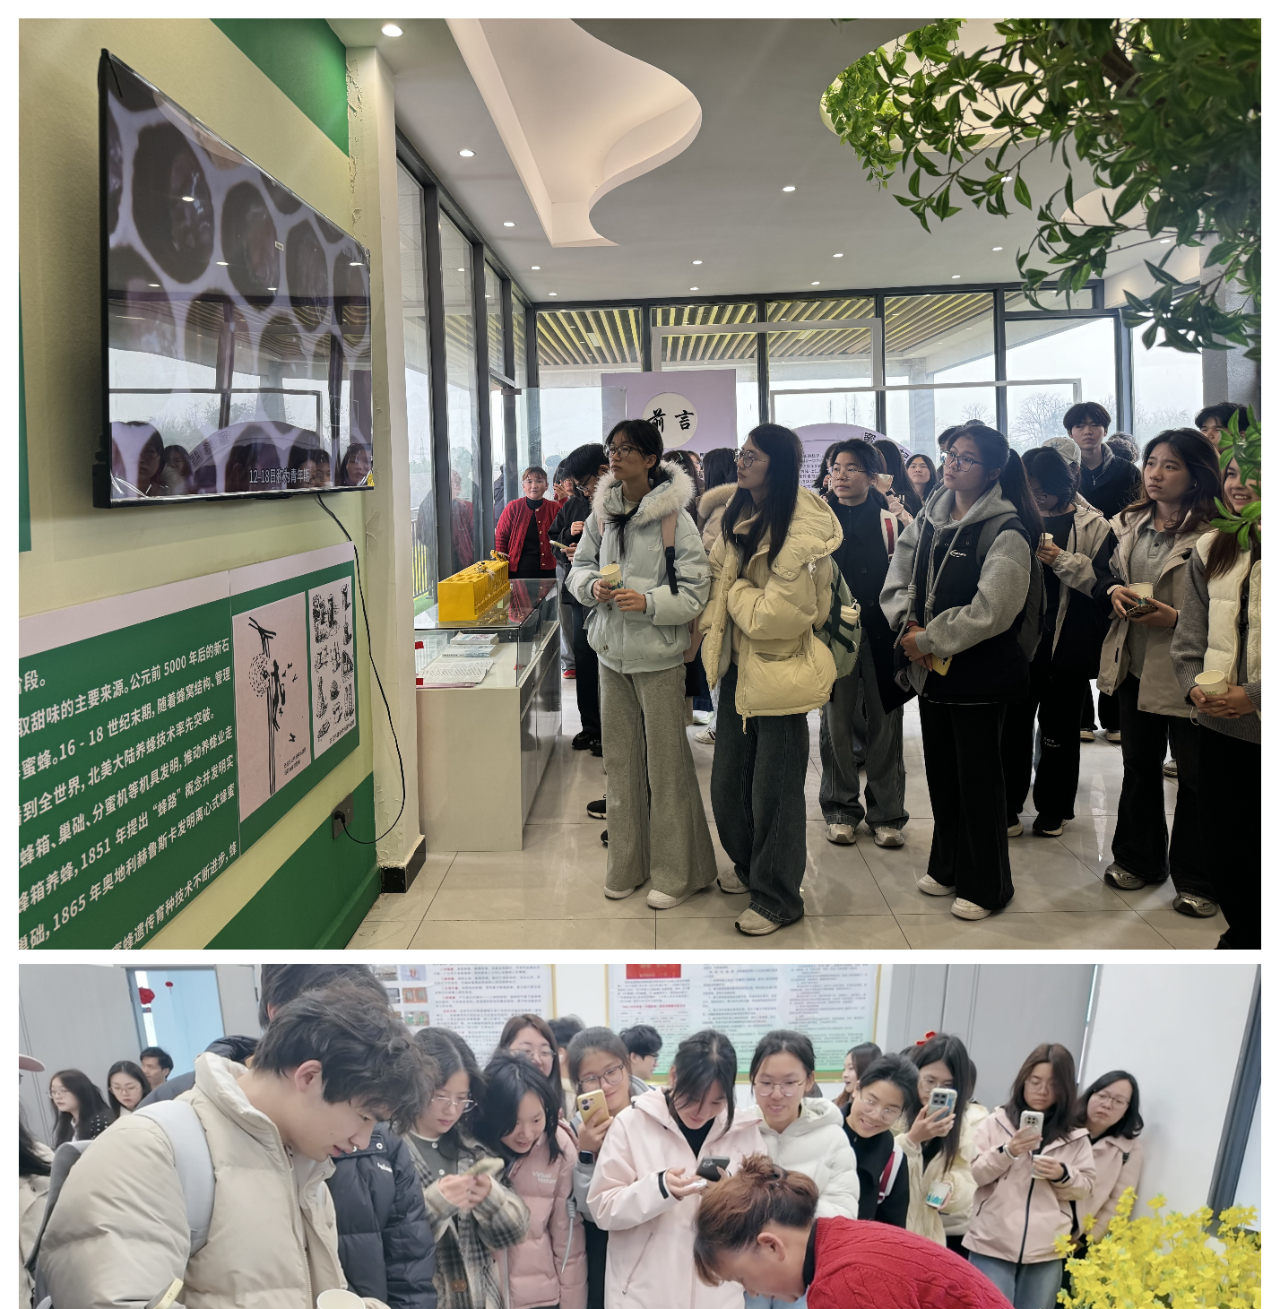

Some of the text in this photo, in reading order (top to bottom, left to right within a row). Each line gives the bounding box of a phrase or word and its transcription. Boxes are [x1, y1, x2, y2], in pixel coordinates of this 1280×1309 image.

[647, 407, 695, 433] 前言
[164, 655, 187, 676] 5000
[189, 637, 230, 666] 年后的新石
[19, 739, 76, 780] 蜜蜂。16
[89, 726, 104, 747] 18
[19, 706, 214, 827] 到全世界，北美大陆养蜂技术率先突破。
